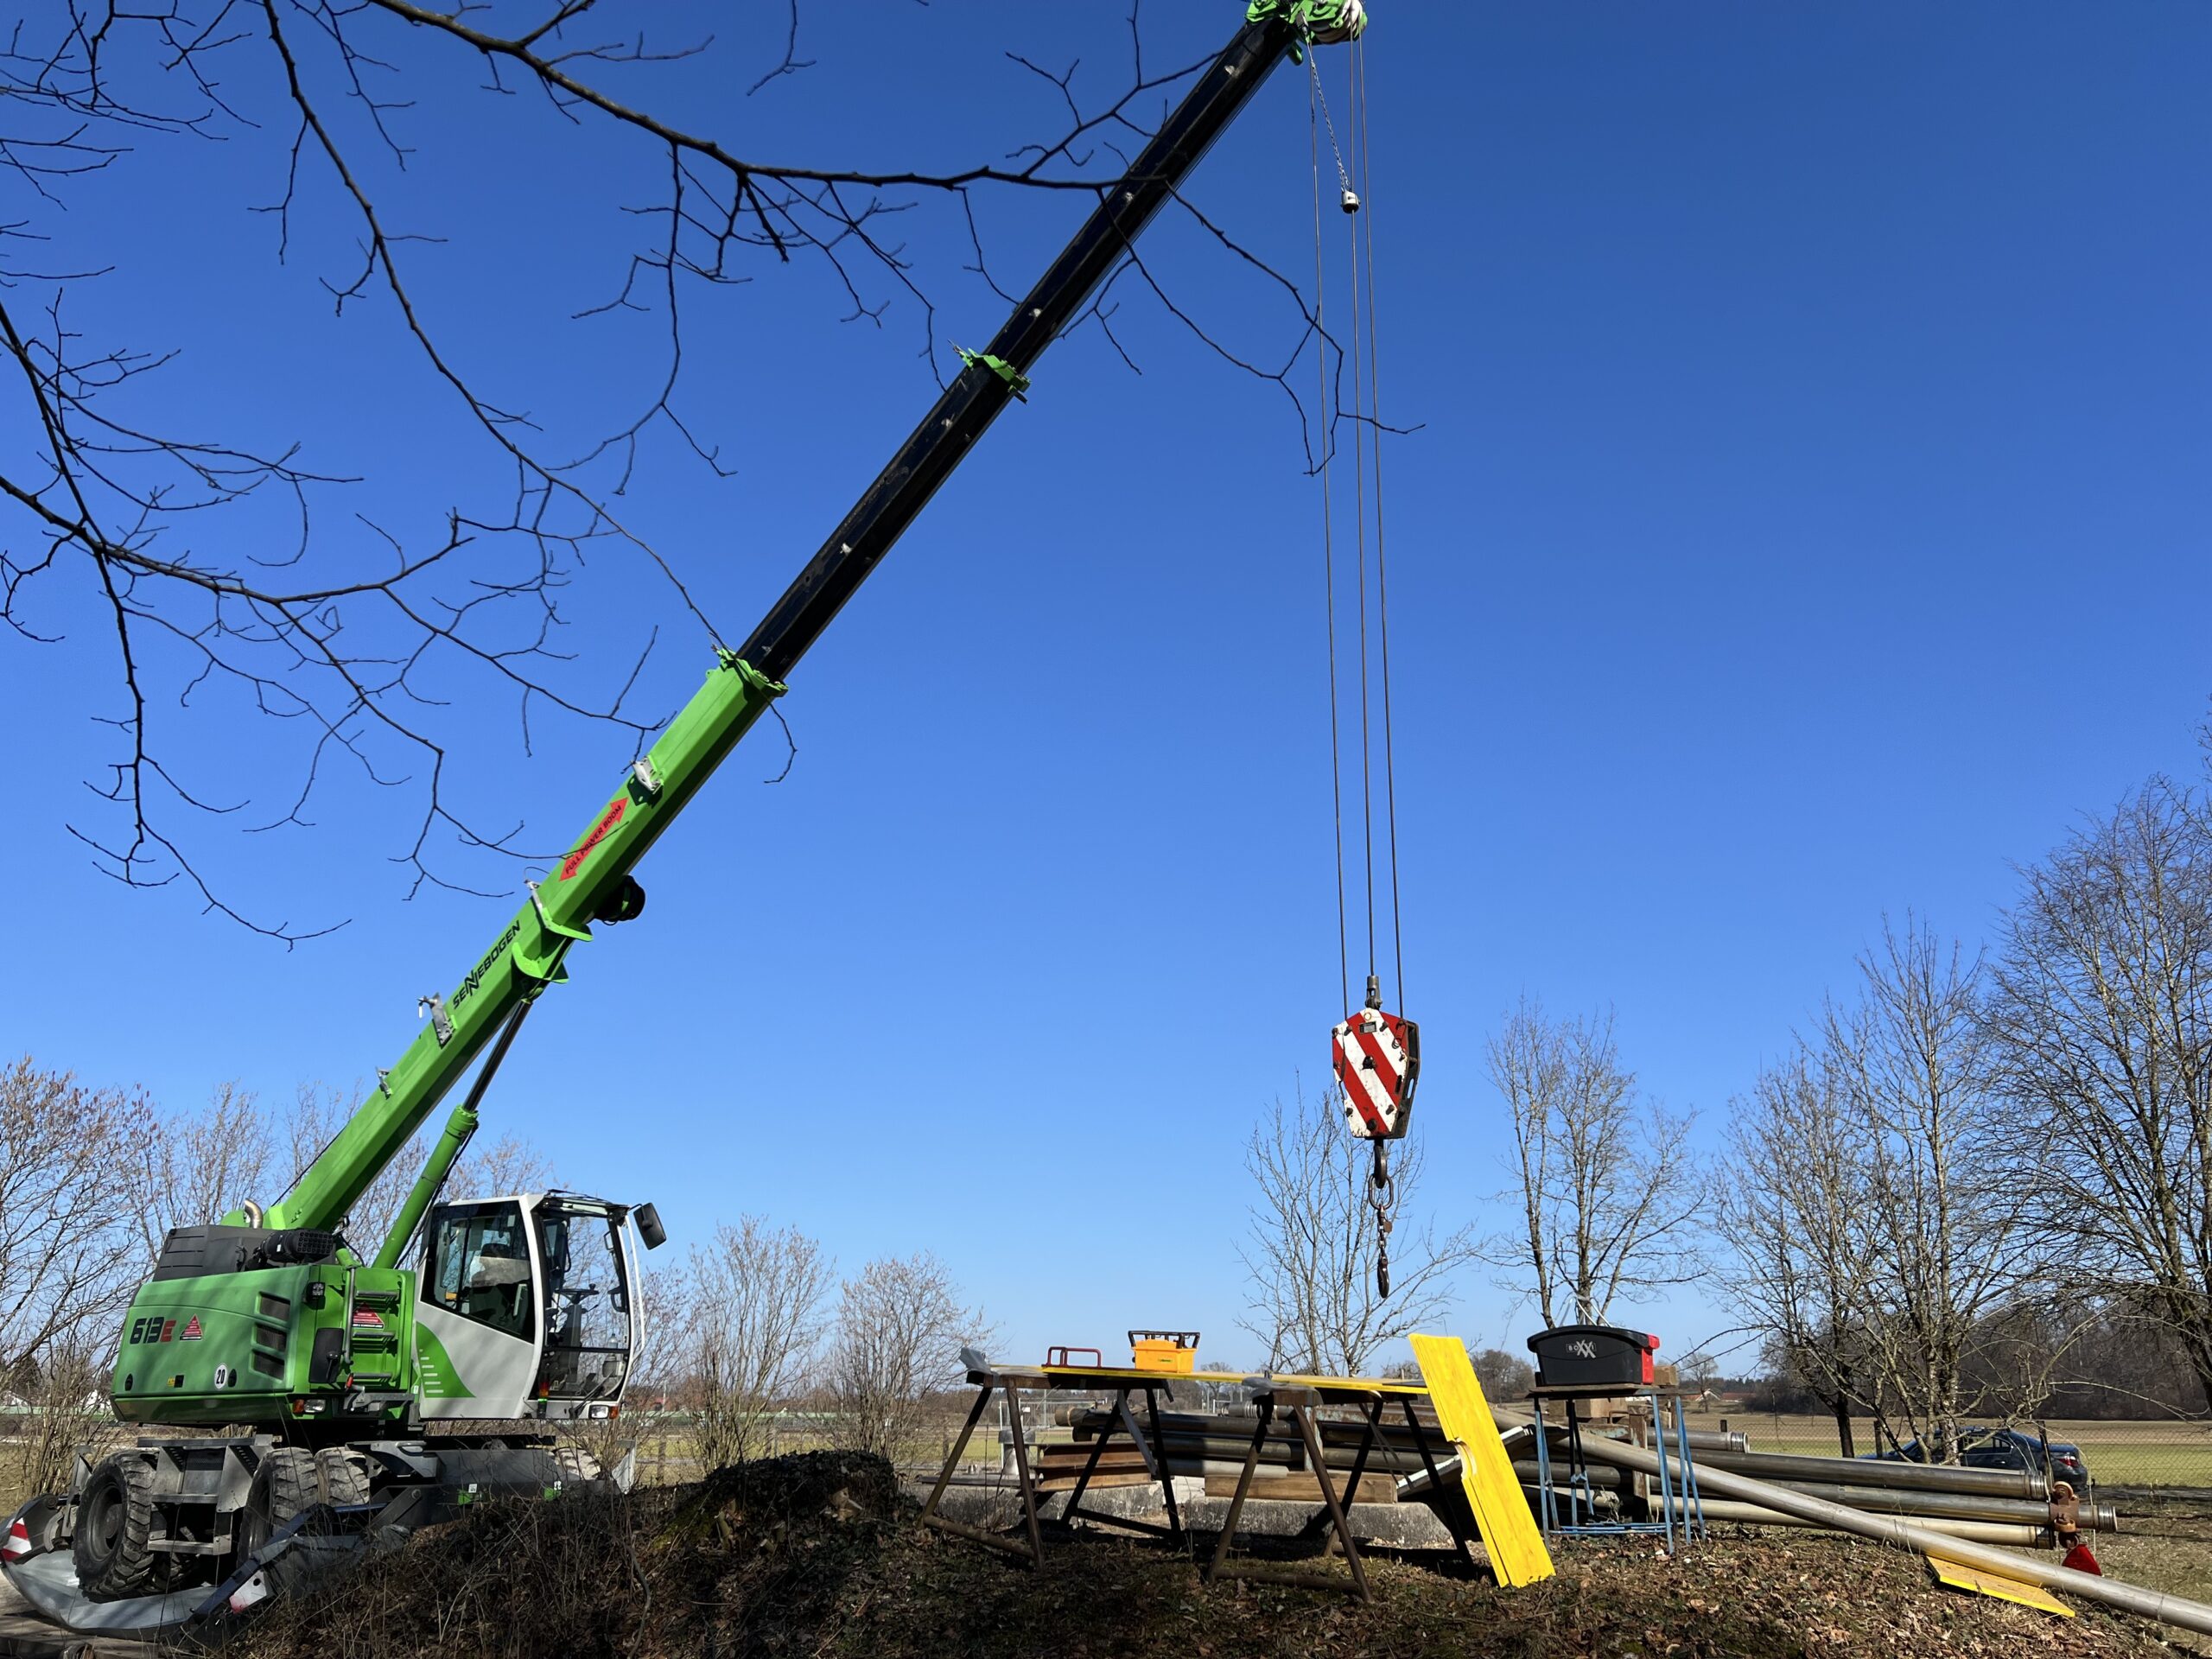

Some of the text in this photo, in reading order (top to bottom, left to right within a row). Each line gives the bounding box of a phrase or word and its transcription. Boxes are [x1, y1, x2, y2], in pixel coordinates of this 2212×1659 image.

[565, 804, 621, 874] FULL POWER BOOM
[453, 919, 521, 1010] SENNEBOGEN
[130, 1316, 177, 1344] 613E
[215, 1369, 226, 1384] 20
